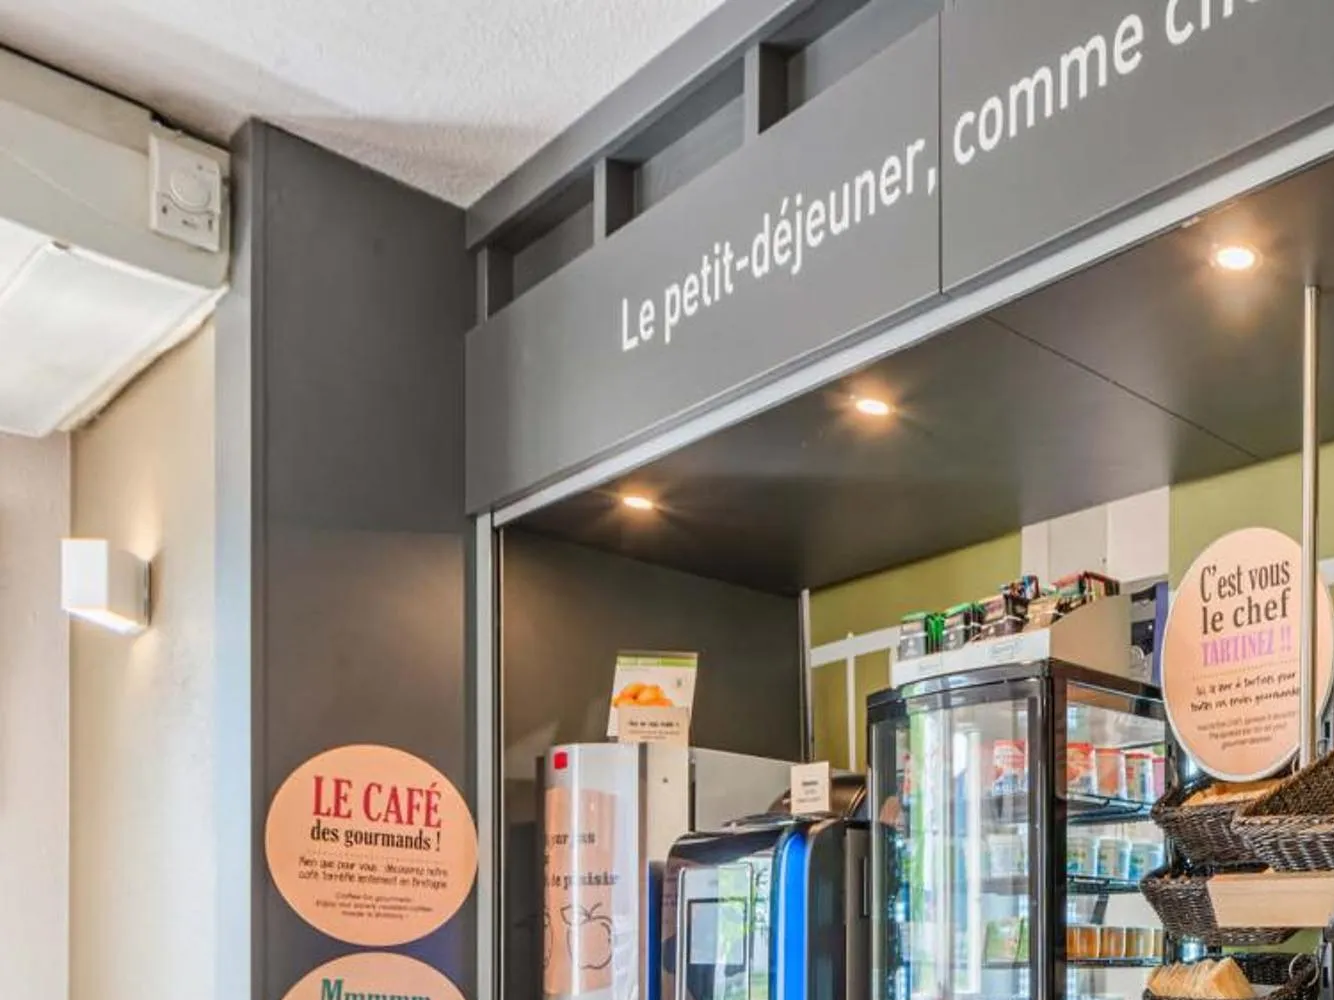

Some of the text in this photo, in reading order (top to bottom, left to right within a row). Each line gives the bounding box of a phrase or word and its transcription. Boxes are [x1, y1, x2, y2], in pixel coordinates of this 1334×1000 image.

[622, 14, 1144, 351] Le petit-déjeuner, comme
[1201, 560, 1291, 603] C'est vous
[1202, 587, 1292, 635] le chef
[1202, 632, 1275, 667] TARTINEZ
[312, 775, 442, 829] LE CAFÉ
[310, 819, 340, 842] des
[343, 829, 432, 851] gourmands
